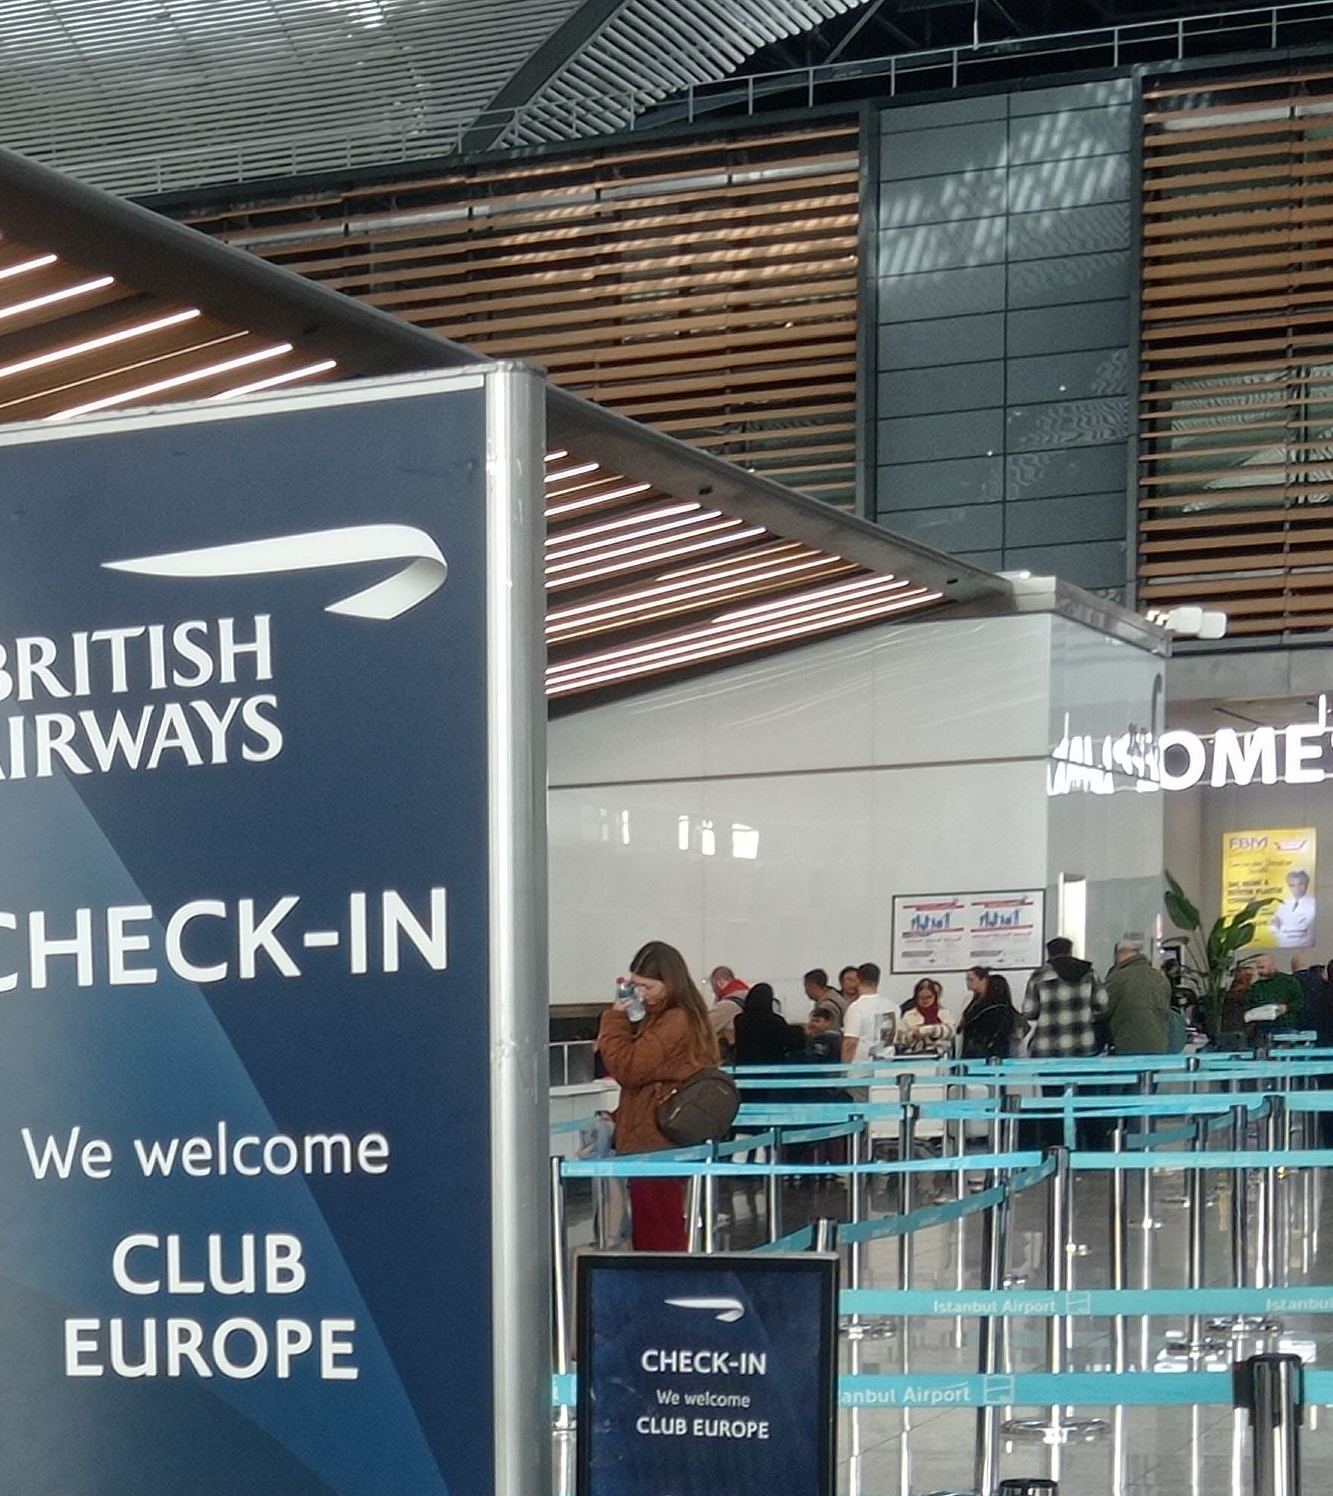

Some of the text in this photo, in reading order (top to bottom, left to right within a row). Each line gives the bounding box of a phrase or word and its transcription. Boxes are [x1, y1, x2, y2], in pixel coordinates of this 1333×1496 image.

[21, 1121, 390, 1180] We welcome
[112, 1233, 306, 1294] CLUB
[934, 1299, 1056, 1315] Istanbul Airport
[65, 1317, 359, 1380] EUROPE
[641, 1349, 766, 1375] CHECK-IN
[656, 1389, 751, 1408] We welcome
[903, 1386, 971, 1405] Airport
[636, 1417, 770, 1439] CLUB EUROPE
